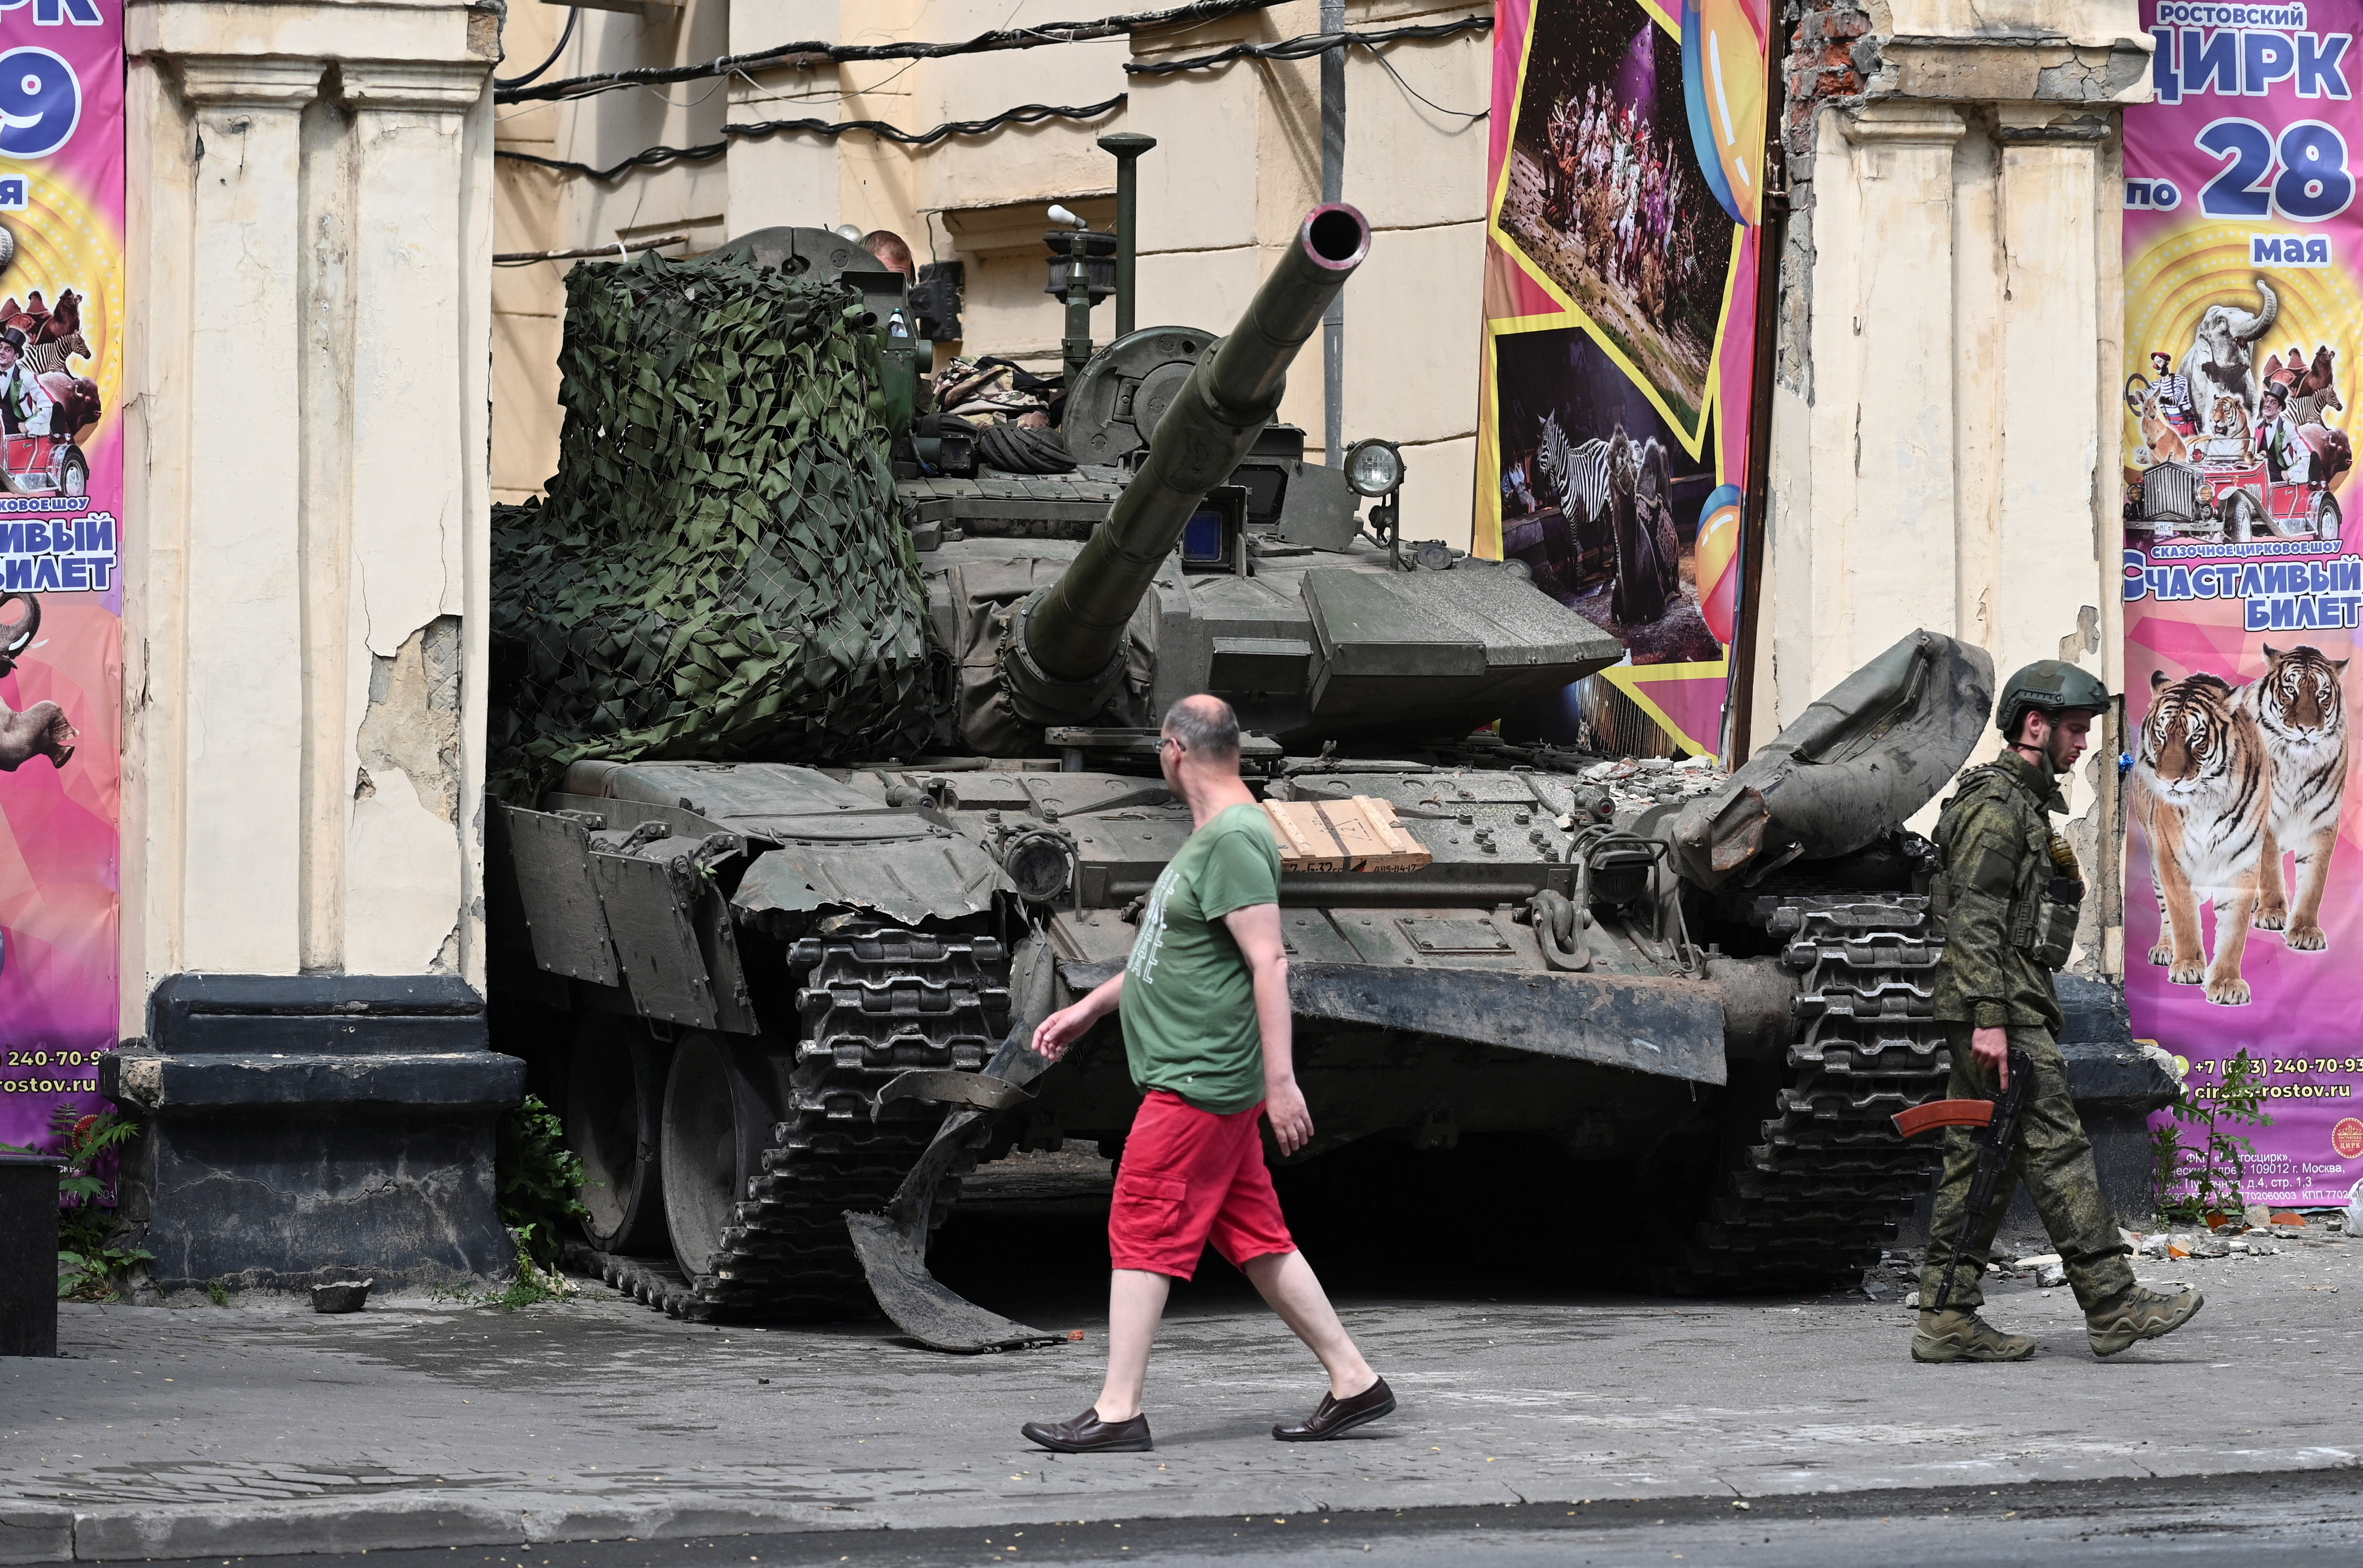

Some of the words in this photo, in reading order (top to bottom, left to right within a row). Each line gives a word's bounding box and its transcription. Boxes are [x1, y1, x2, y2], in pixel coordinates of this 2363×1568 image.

[2160, 5, 2304, 26] РОСТОВСКИЙ
[2152, 30, 2349, 101] ЦИРК
[2126, 182, 2177, 206] по
[2199, 122, 2351, 217] 28
[2254, 238, 2328, 263] мая
[52, 498, 88, 509] ШОУ
[2152, 545, 2234, 557] СКАЗОЧНОЕ
[2236, 542, 2308, 556] ЦИРКОВОЕ
[2310, 541, 2341, 552] ШОУ
[0, 556, 114, 590] ИЛЕТ
[2124, 552, 2361, 598] СЧАСТЛИВЫЙ
[2247, 596, 2362, 628] БИЛЕТ
[8, 1051, 101, 1066] 240-70-9
[2195, 1061, 2216, 1074] +7
[2221, 1059, 2267, 1077] (83)
[2273, 1057, 2363, 1074] 240-70-93
[2250, 1163, 2290, 1175] 109012
[2302, 1162, 2345, 1174] Москва,
[2247, 1177, 2268, 1190] д.4,
[2270, 1180, 2292, 1190] стр.
[2296, 1176, 2312, 1188] 1,3
[2239, 1191, 2297, 1200] 7702060003
[2302, 1190, 2323, 1200] КПП
